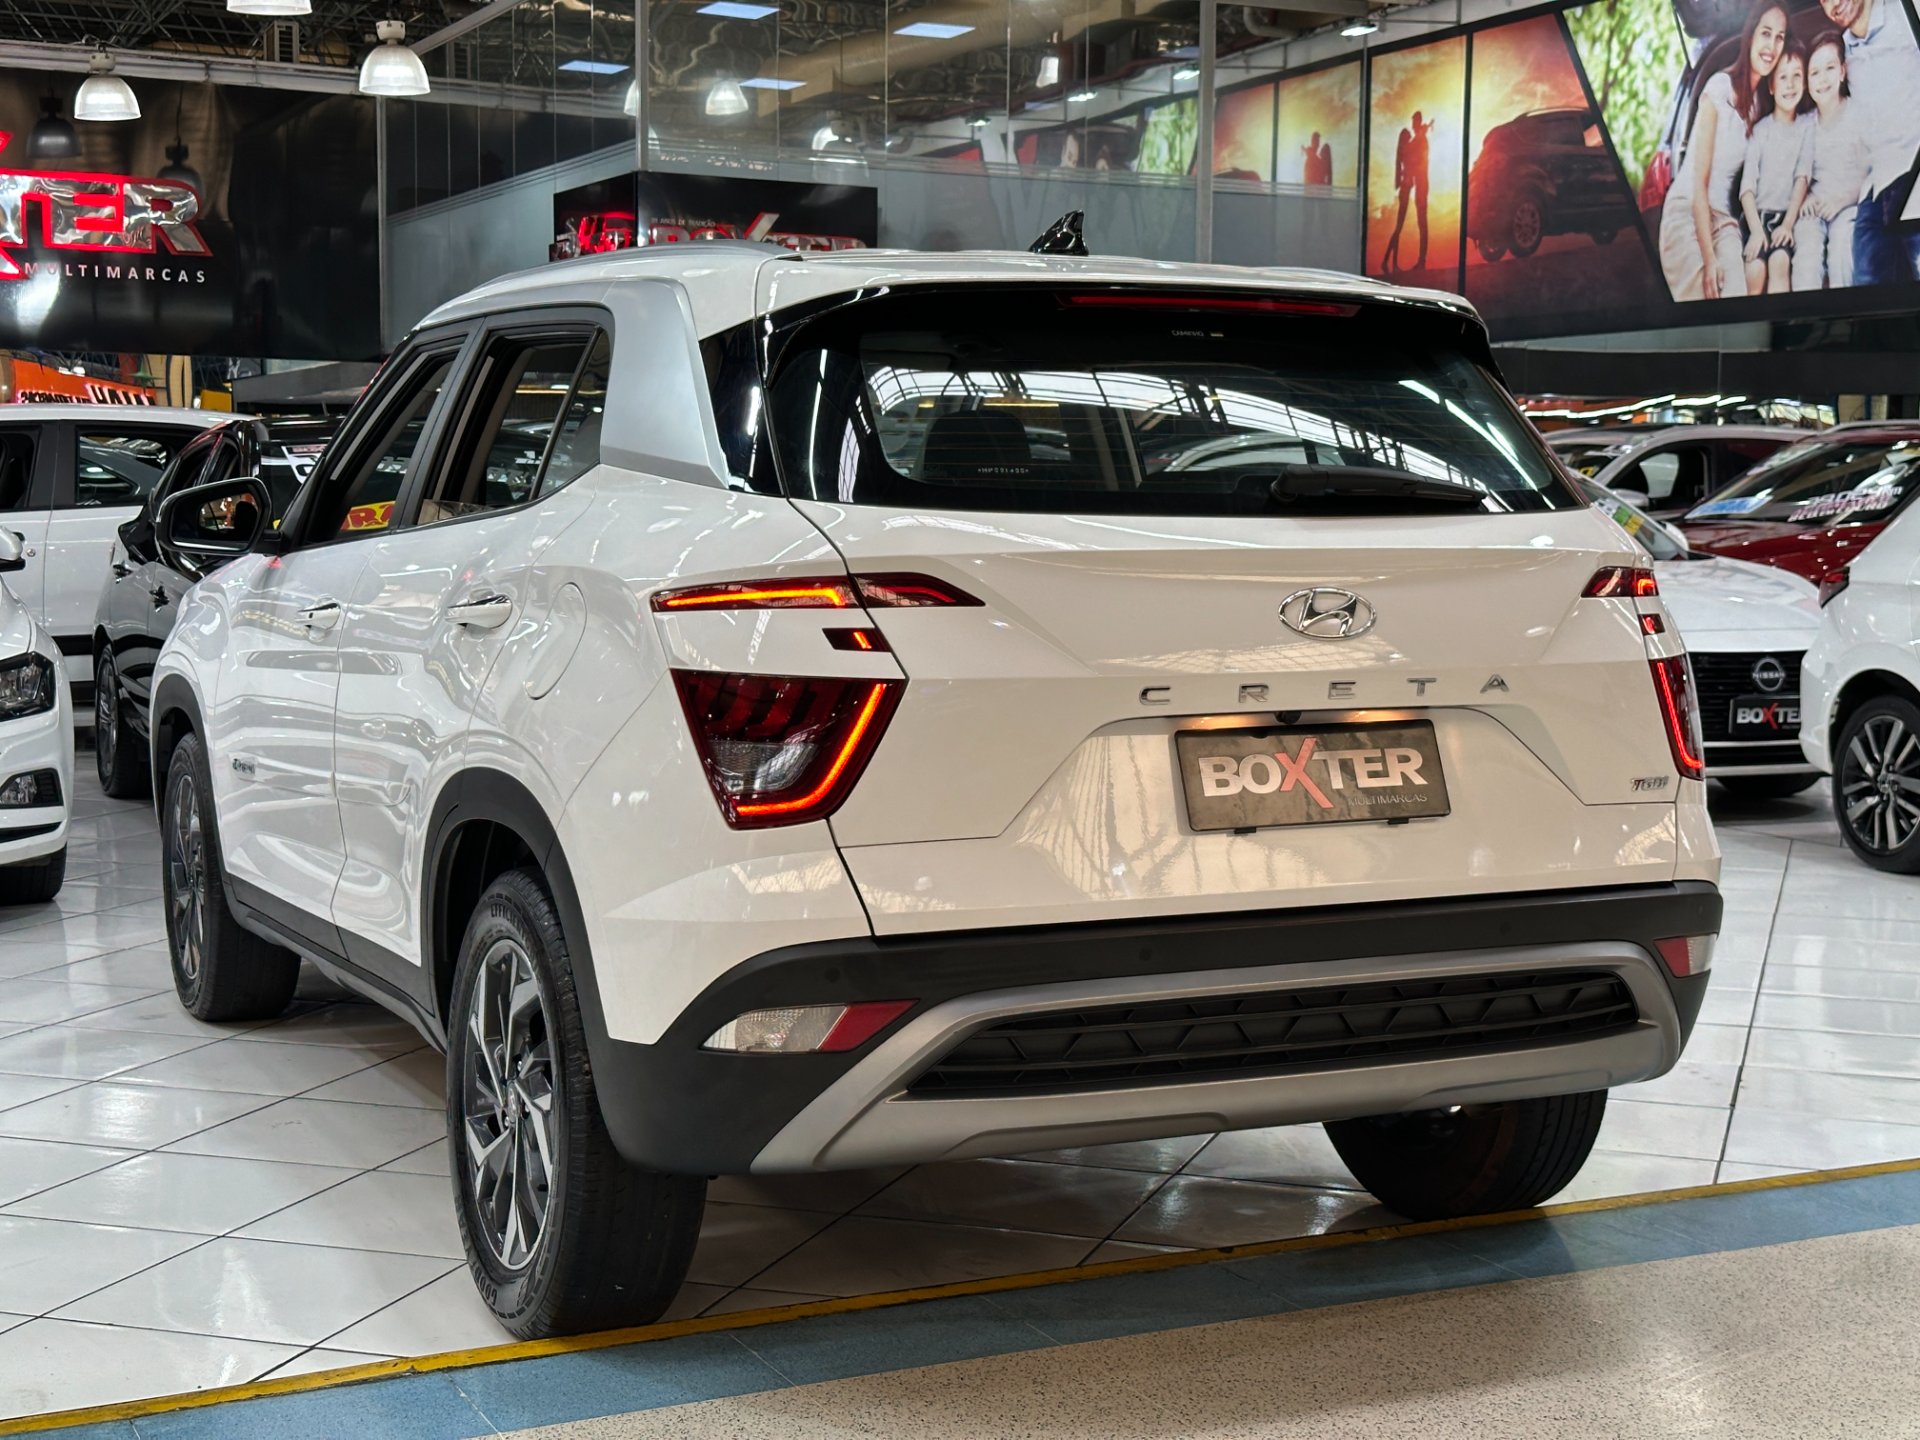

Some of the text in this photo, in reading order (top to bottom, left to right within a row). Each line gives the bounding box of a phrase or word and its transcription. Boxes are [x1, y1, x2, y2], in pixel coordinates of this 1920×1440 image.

[25, 262, 205, 284] MULTIMARCAS
[1138, 673, 1510, 705] CRETA
[1736, 703, 1801, 730] BOXTE
[1198, 737, 1429, 809] BOXTER
